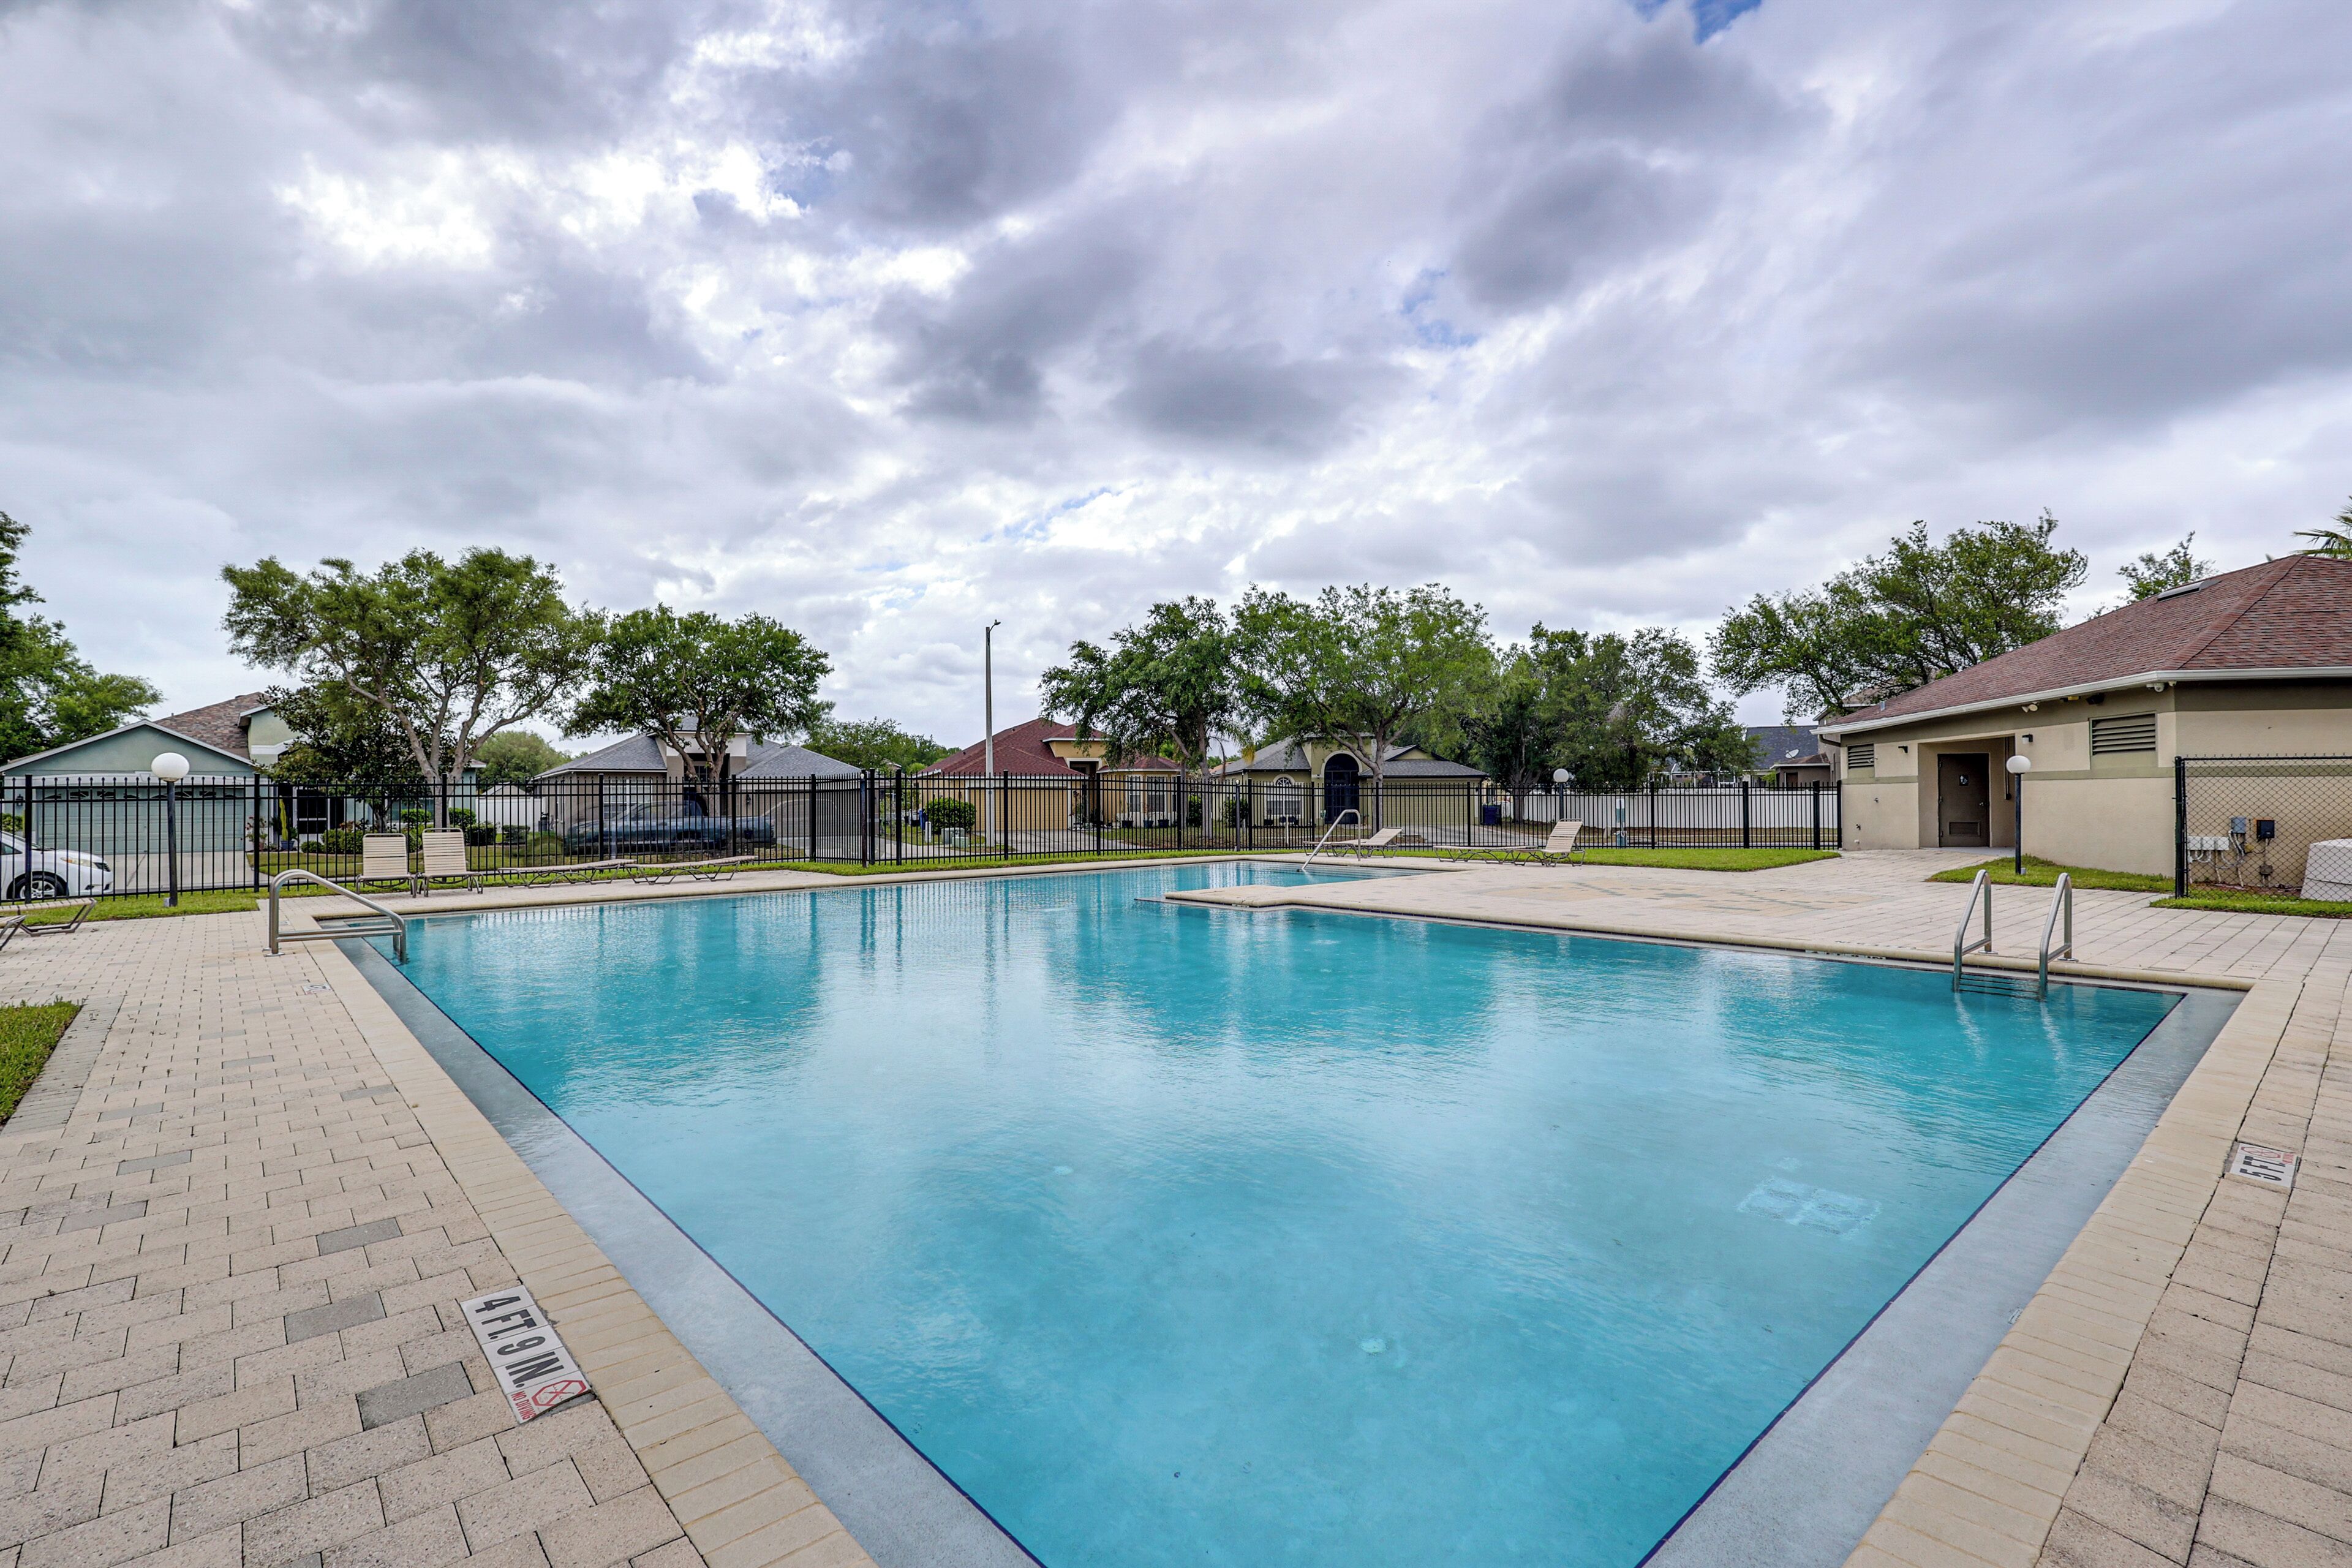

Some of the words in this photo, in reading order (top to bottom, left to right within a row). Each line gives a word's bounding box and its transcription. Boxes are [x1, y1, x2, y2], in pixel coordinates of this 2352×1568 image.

[2242, 1155, 2286, 1174] FT.
[2239, 1168, 2282, 1181] 5
[475, 1296, 521, 1313] 4
[481, 1309, 537, 1340] FT.
[497, 1336, 546, 1355] 9
[505, 1351, 565, 1388] IN.
[511, 1390, 527, 1401] NO
[515, 1399, 537, 1420] DIVING
